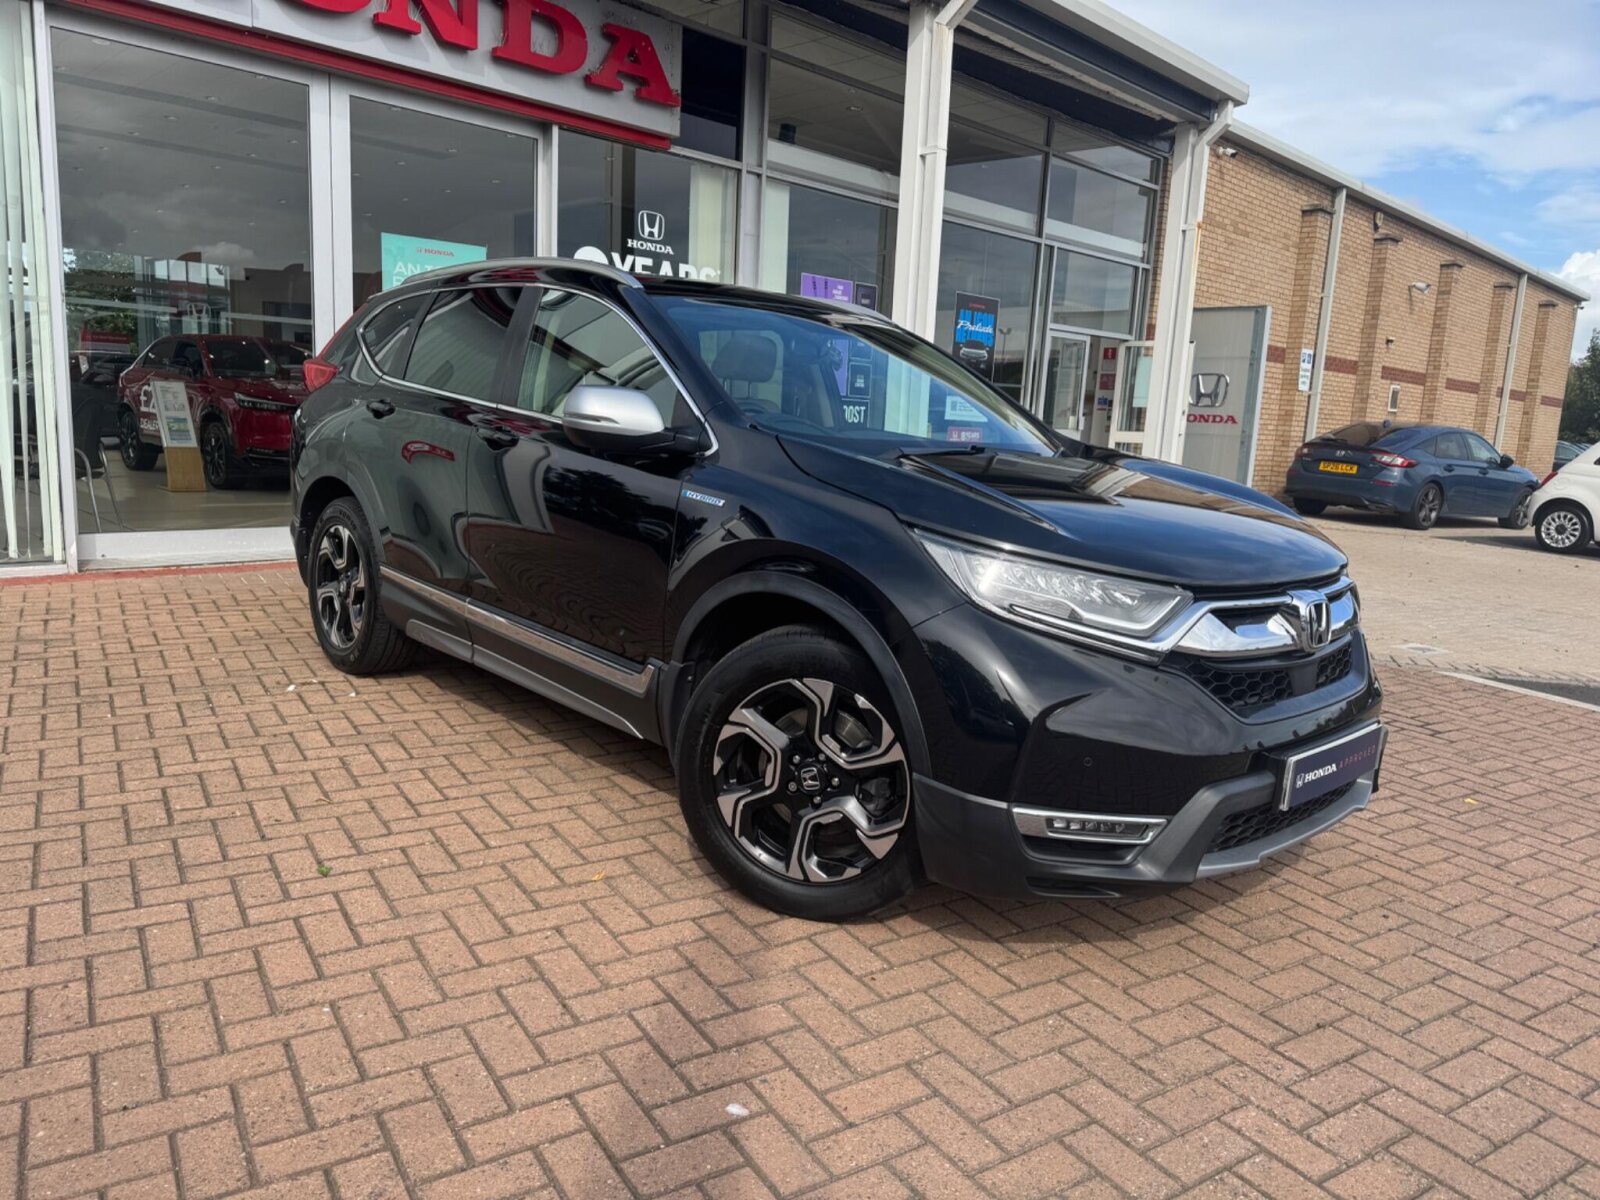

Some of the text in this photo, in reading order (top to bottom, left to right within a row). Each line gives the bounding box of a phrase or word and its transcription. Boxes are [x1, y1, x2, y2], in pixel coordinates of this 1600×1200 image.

[285, 0, 680, 107] NDA
[424, 248, 455, 257] HONDA
[627, 239, 675, 255] HONDA
[393, 261, 420, 276] AN
[686, 490, 725, 506] HYBRID
[1304, 763, 1337, 783] HONDA
